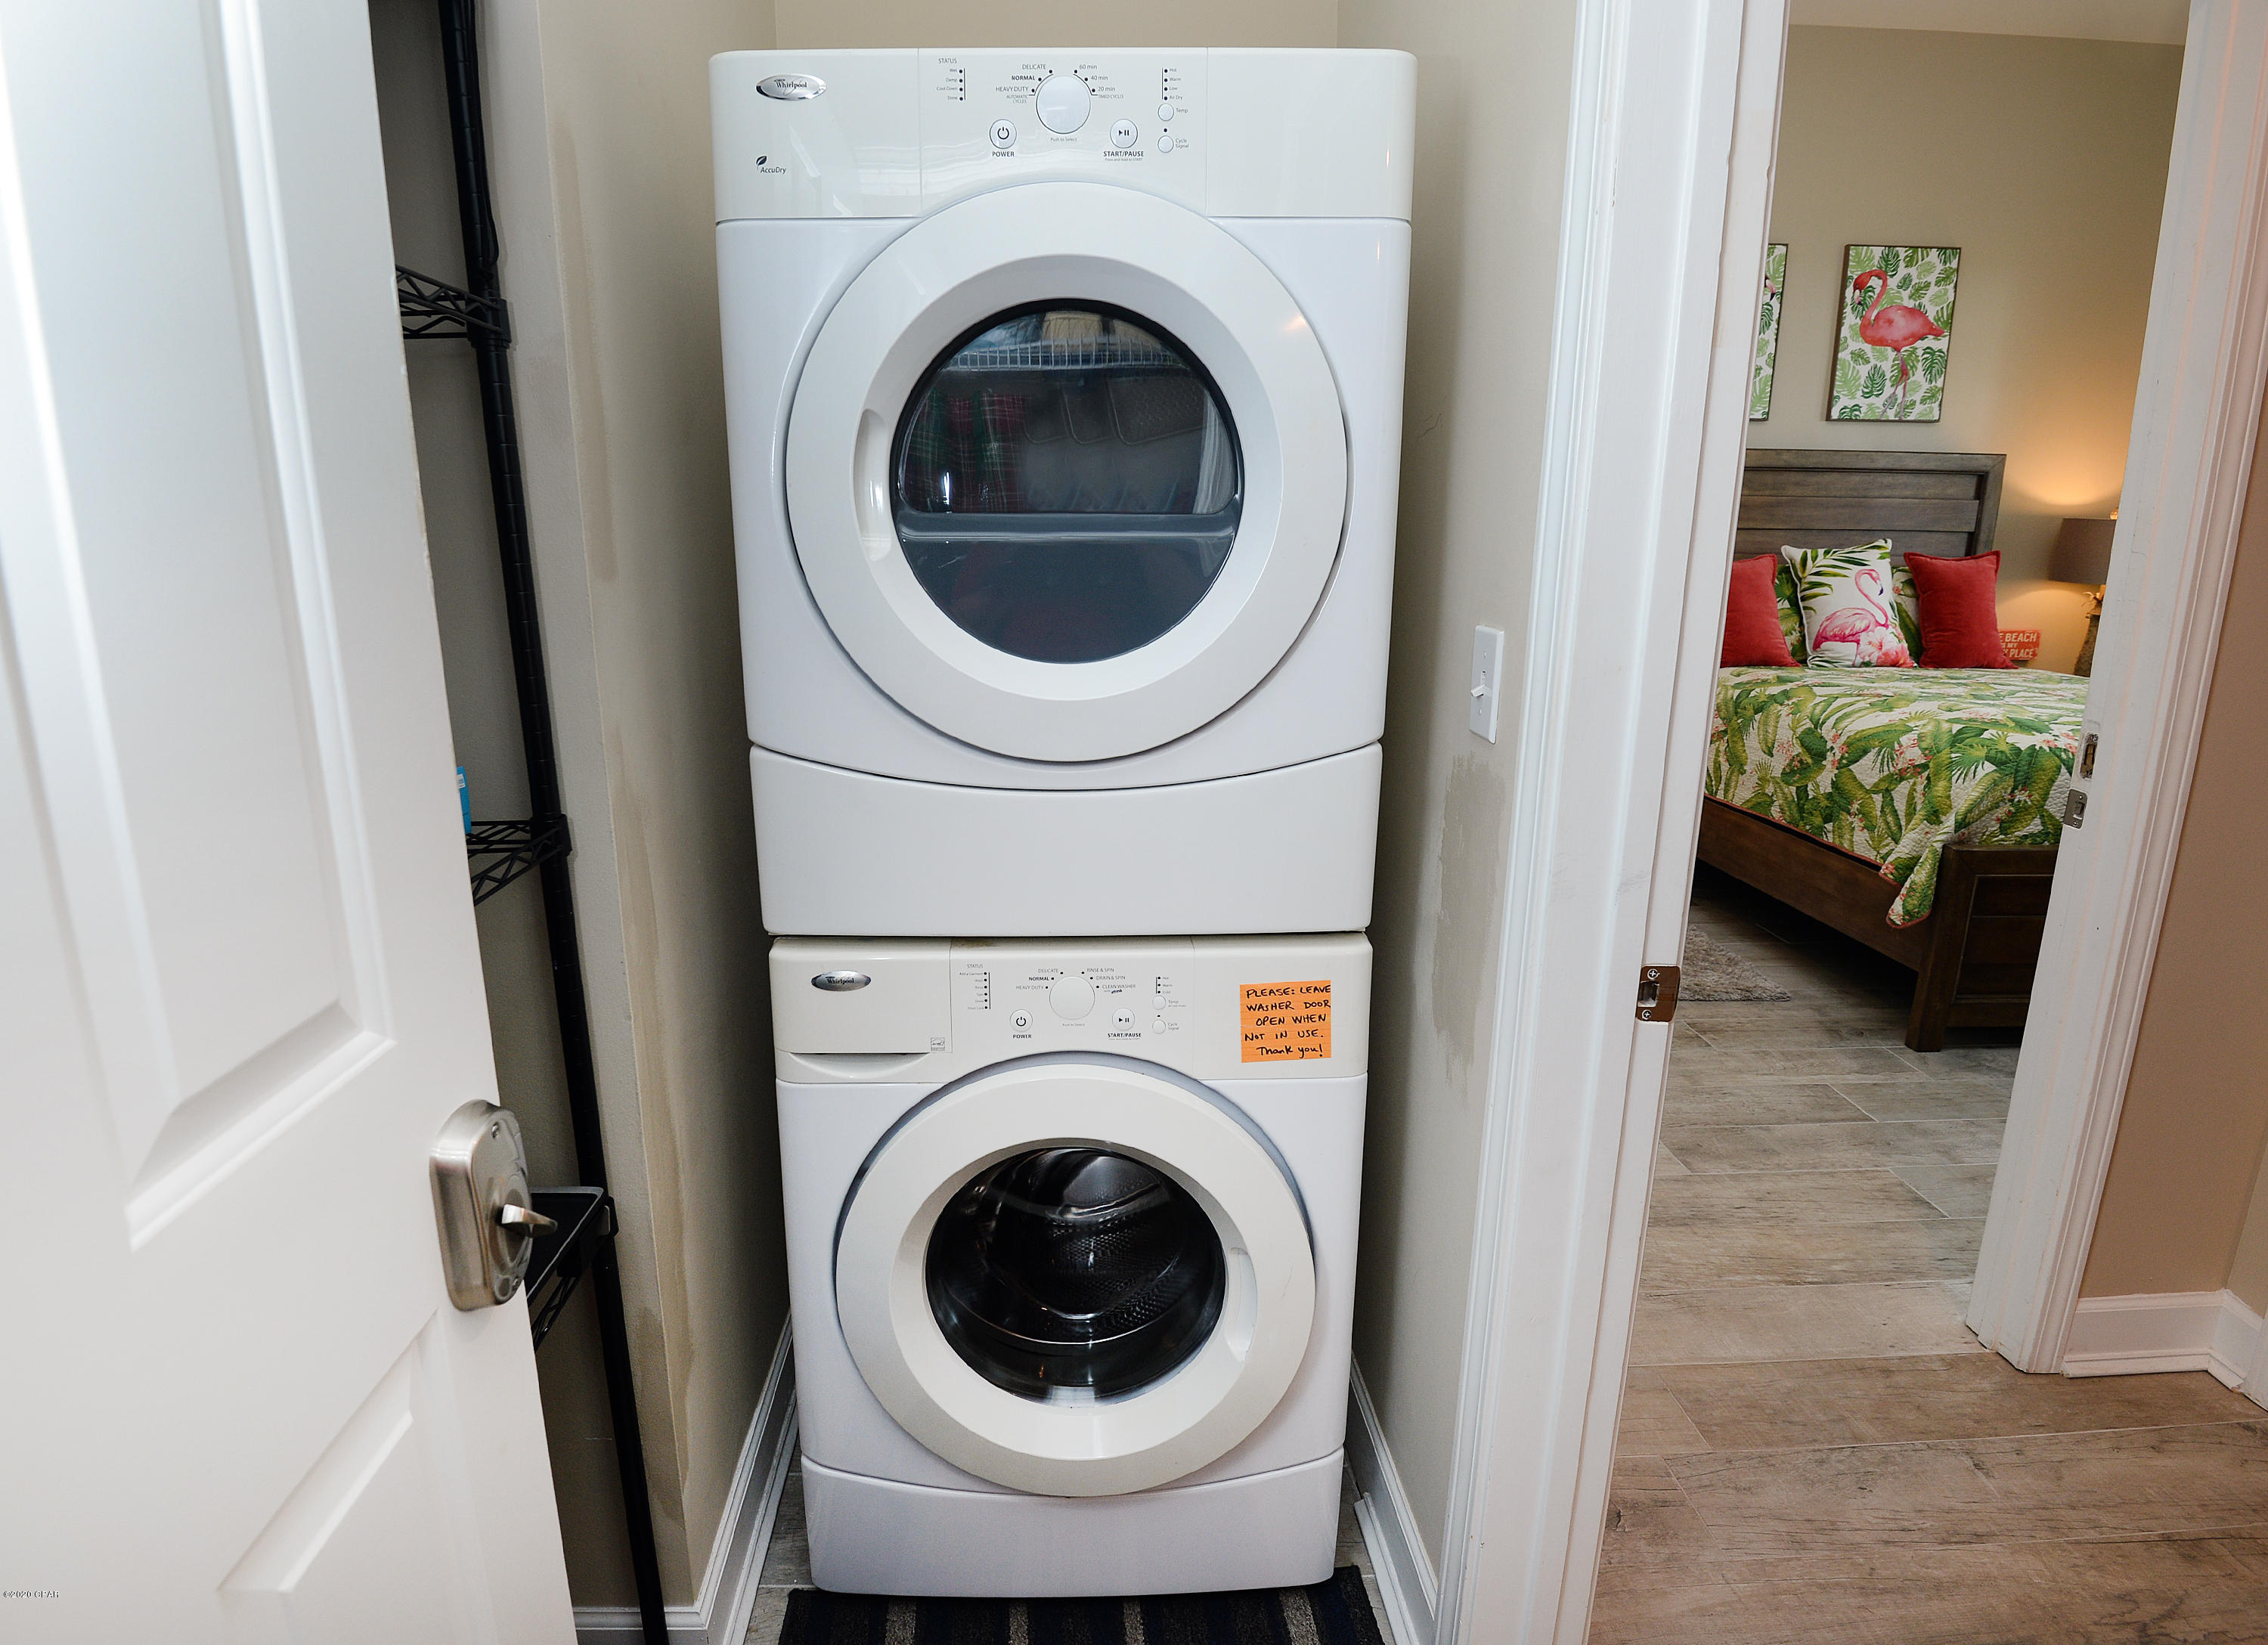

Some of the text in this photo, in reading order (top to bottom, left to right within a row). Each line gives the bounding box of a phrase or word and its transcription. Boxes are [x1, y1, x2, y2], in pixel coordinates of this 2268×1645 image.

[2005, 633, 2037, 642] BEACH
[2009, 649, 2034, 658] PLACE
[1247, 985, 1331, 999] PLEASE: LEAVE
[1246, 999, 1331, 1011] WASHER DOOR
[1256, 1014, 1326, 1026] OPEN WHEN
[1275, 1030, 1287, 1039] IN
[1297, 1029, 1324, 1038] USE.
[1256, 1043, 1323, 1058] Thank you!
